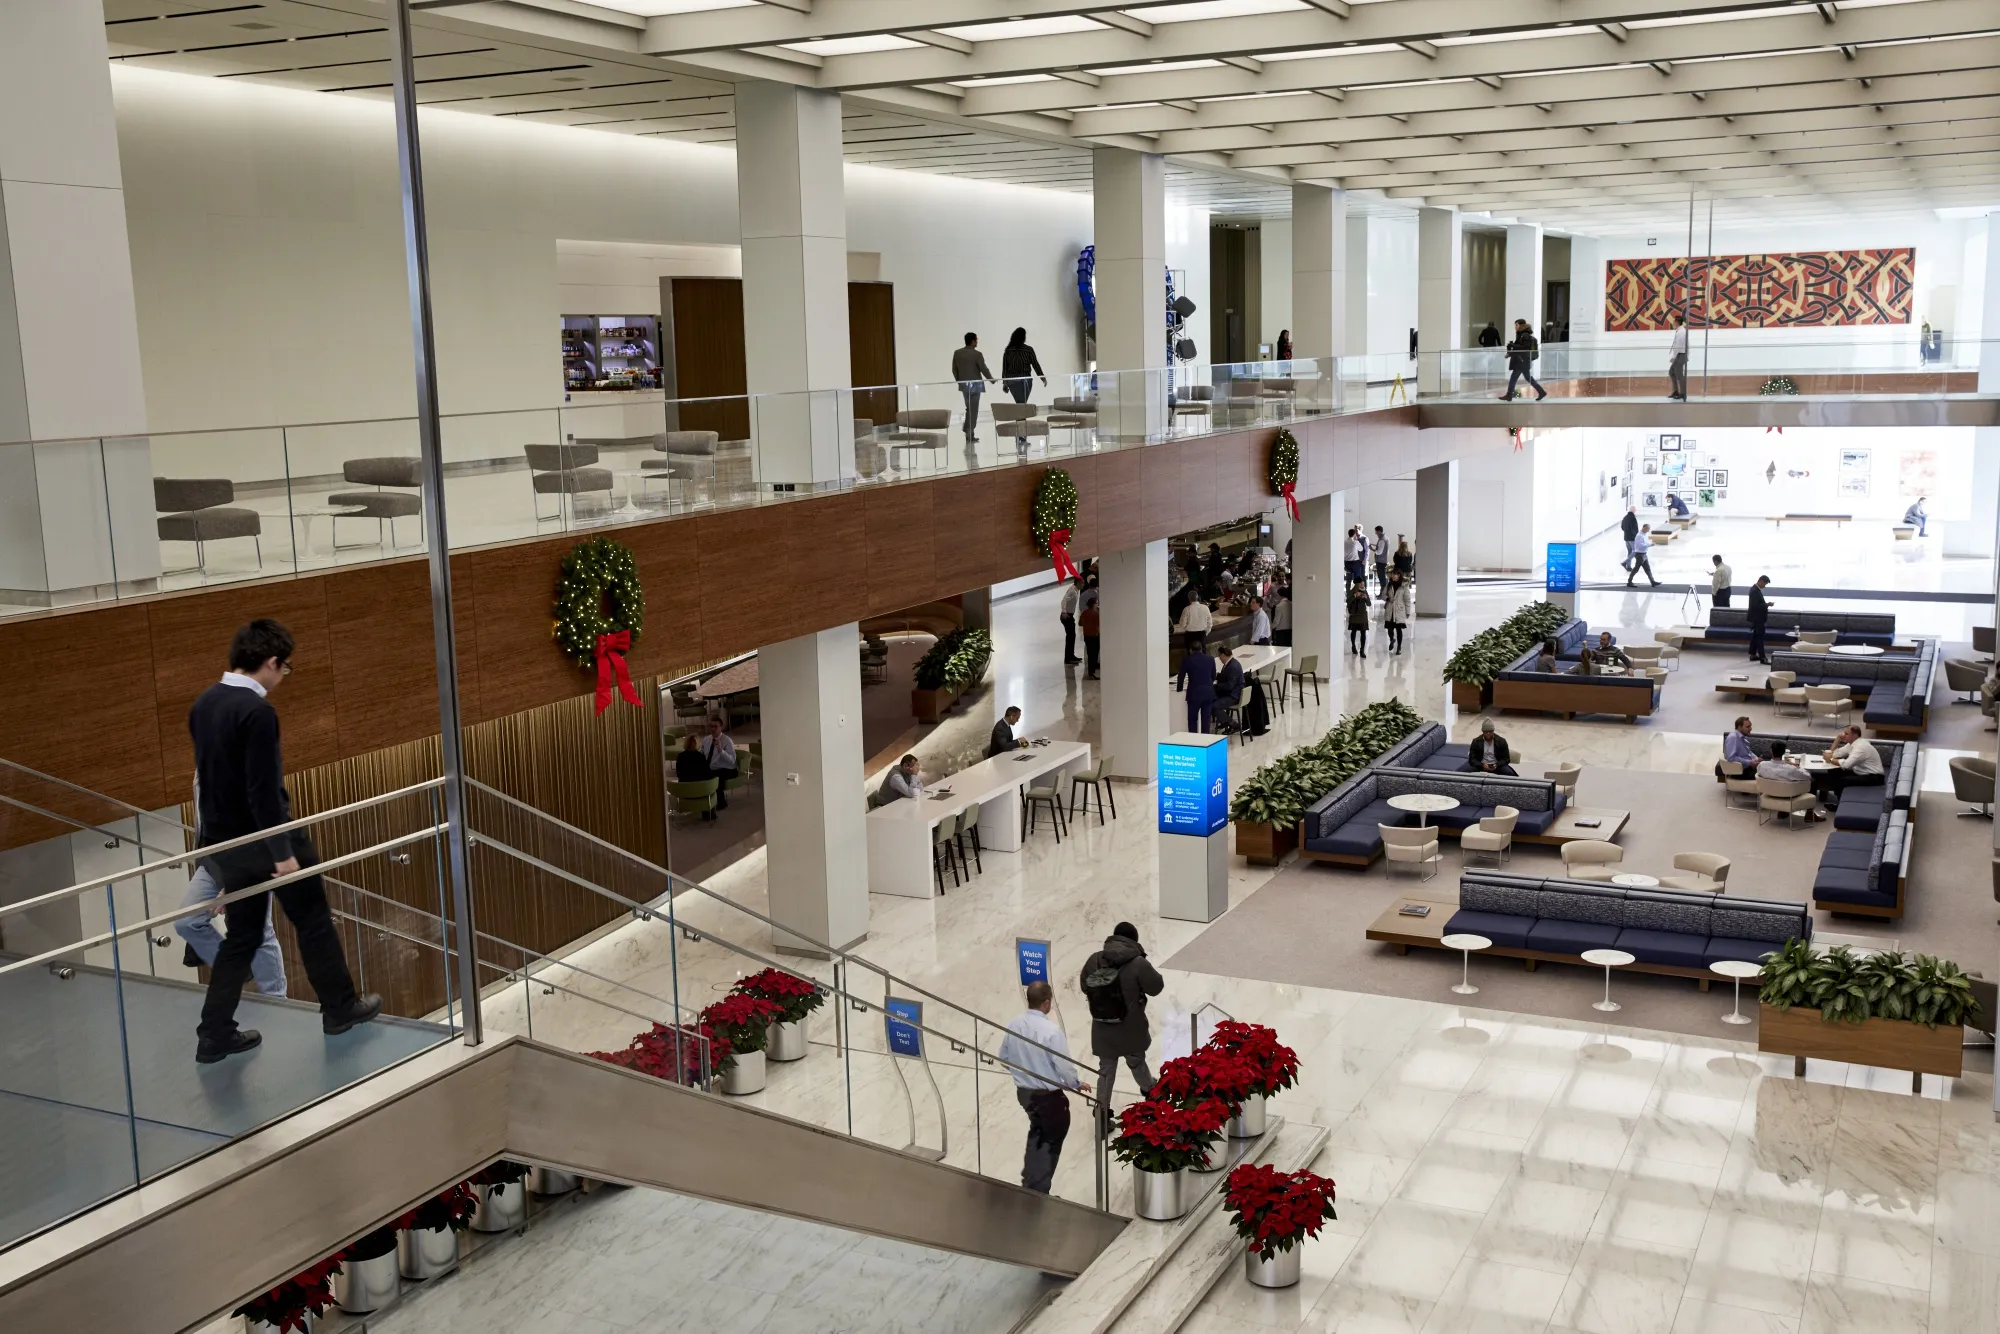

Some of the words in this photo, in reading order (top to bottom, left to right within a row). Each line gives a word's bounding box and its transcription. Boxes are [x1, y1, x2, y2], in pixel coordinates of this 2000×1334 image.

[1211, 777, 1224, 797] citi
[1022, 950, 1043, 958] Watch
[1026, 967, 1041, 975] Step
[896, 1010, 909, 1018] Step
